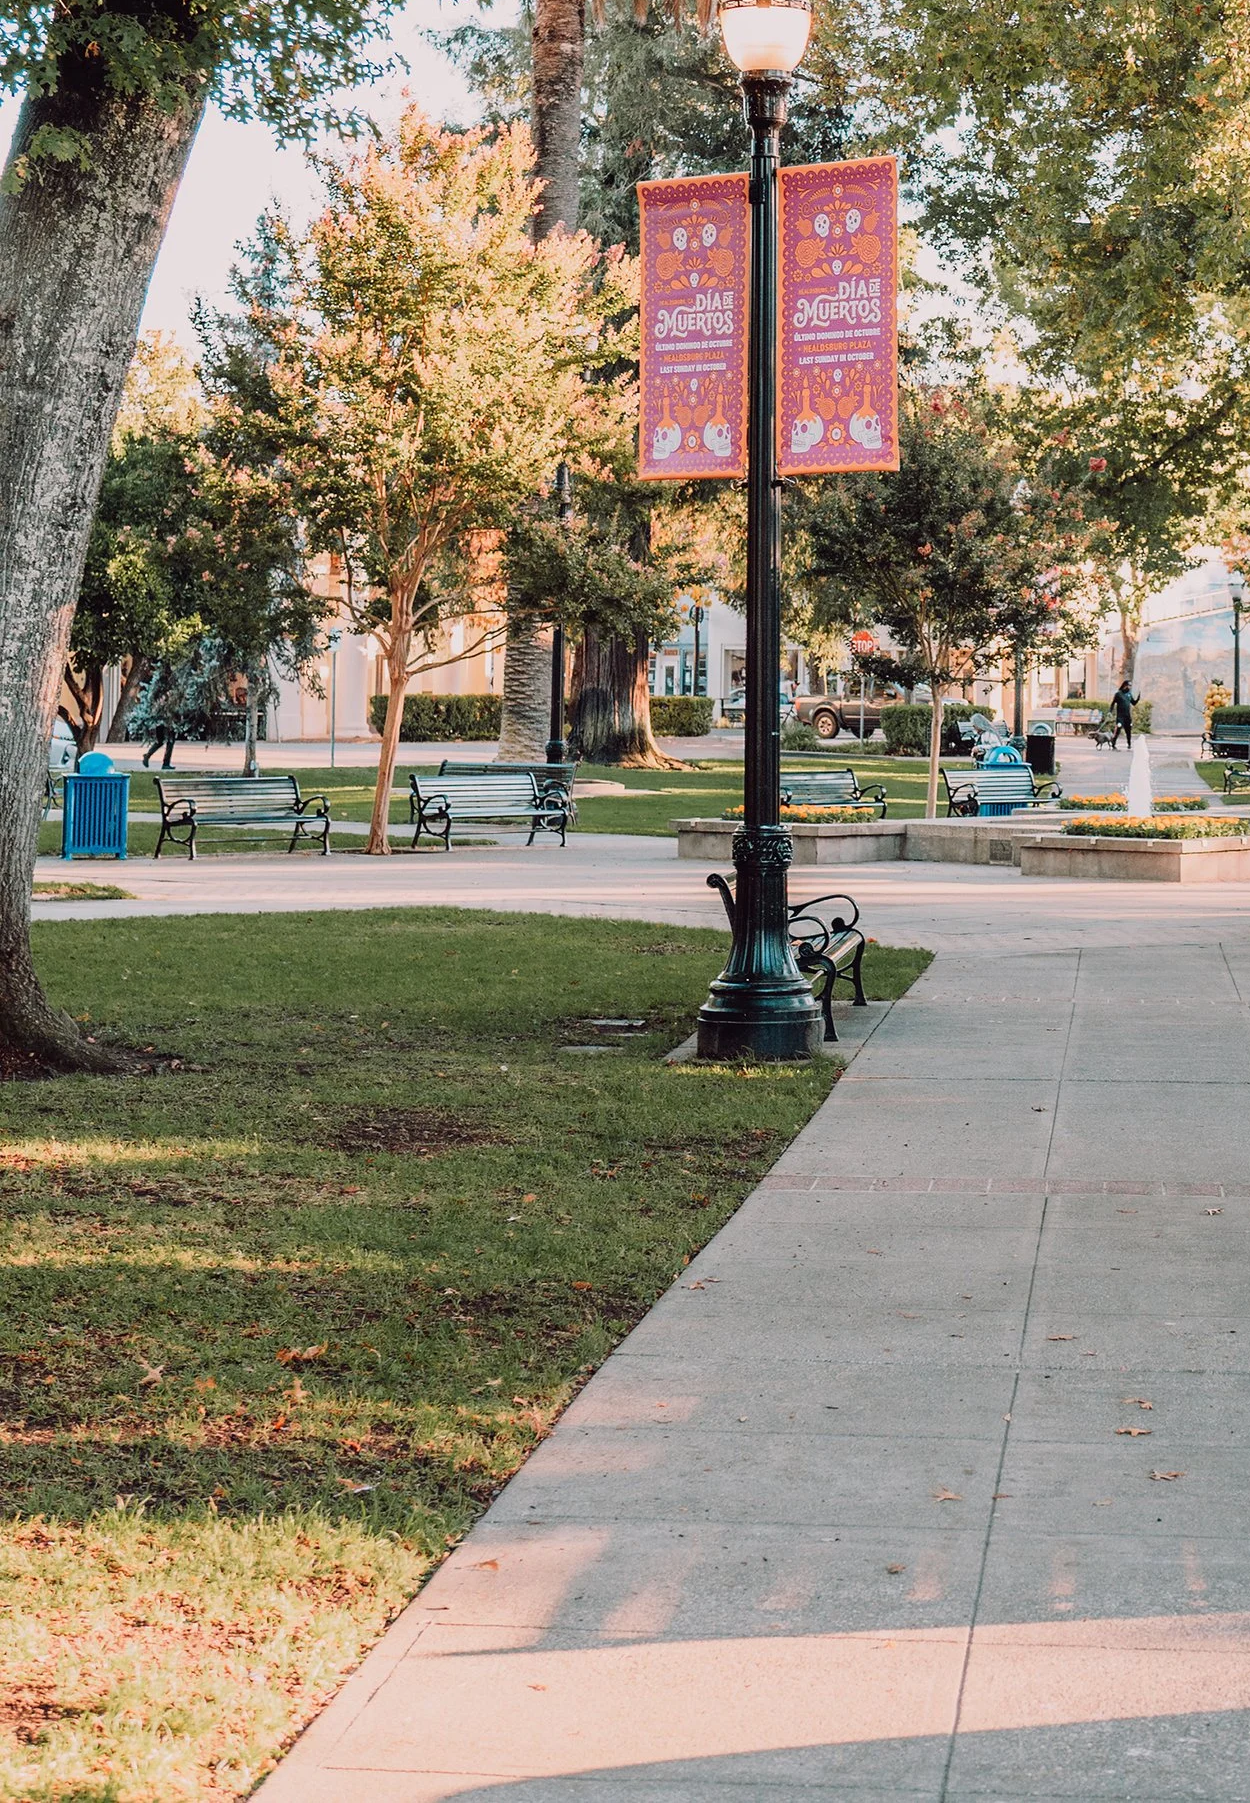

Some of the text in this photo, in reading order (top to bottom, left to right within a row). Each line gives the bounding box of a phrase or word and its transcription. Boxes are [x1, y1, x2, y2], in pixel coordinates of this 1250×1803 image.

[838, 277, 881, 299] DÍA DE
[696, 289, 734, 311] DÍA DE
[793, 294, 881, 328] MUERTOS
[655, 306, 734, 339] MUERTOS
[794, 332, 816, 341] ÚLTIMO
[845, 330, 853, 338] DE
[854, 328, 881, 337] OCTUBRE
[803, 340, 872, 353] HEALDSBURG PLAZA
[704, 351, 724, 360] PLAZA
[799, 352, 874, 365] LAST SUNDAY IN OCTOBER
